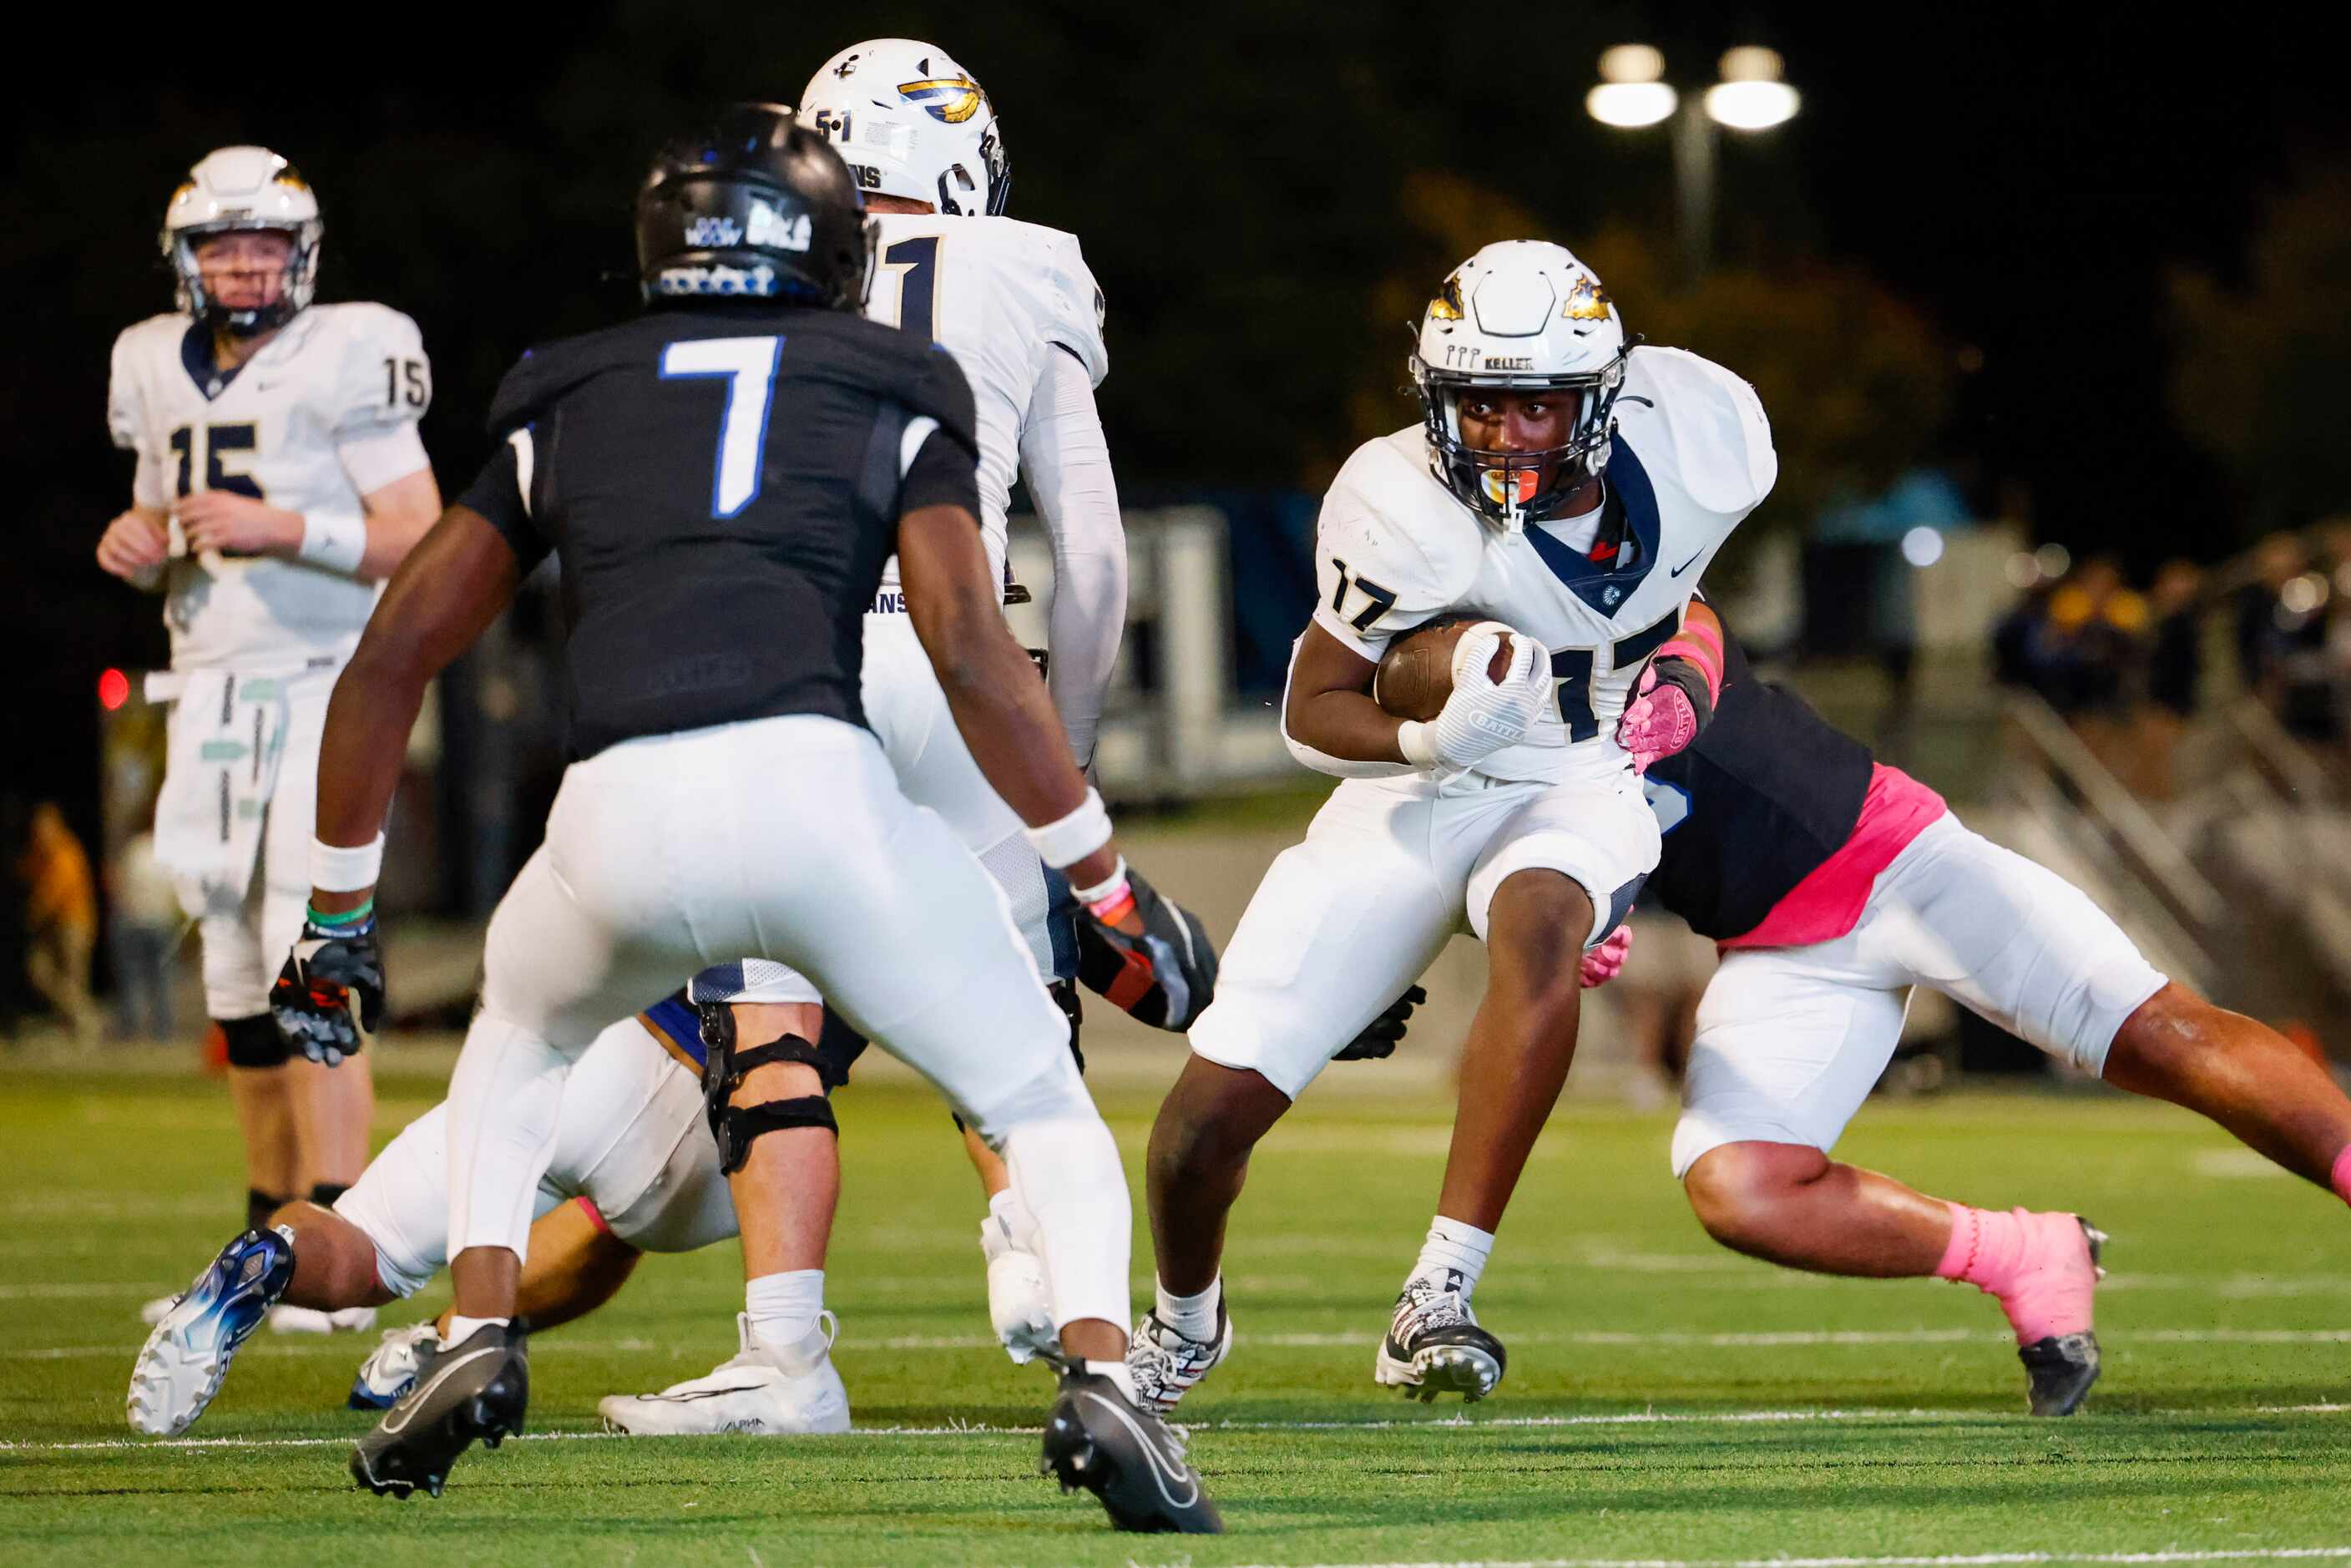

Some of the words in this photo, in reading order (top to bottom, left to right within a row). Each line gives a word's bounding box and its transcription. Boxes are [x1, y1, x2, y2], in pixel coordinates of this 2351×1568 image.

[382, 357, 429, 408] 15
[658, 336, 786, 518] 7
[170, 422, 265, 560] 15
[1331, 557, 1399, 635] 17
